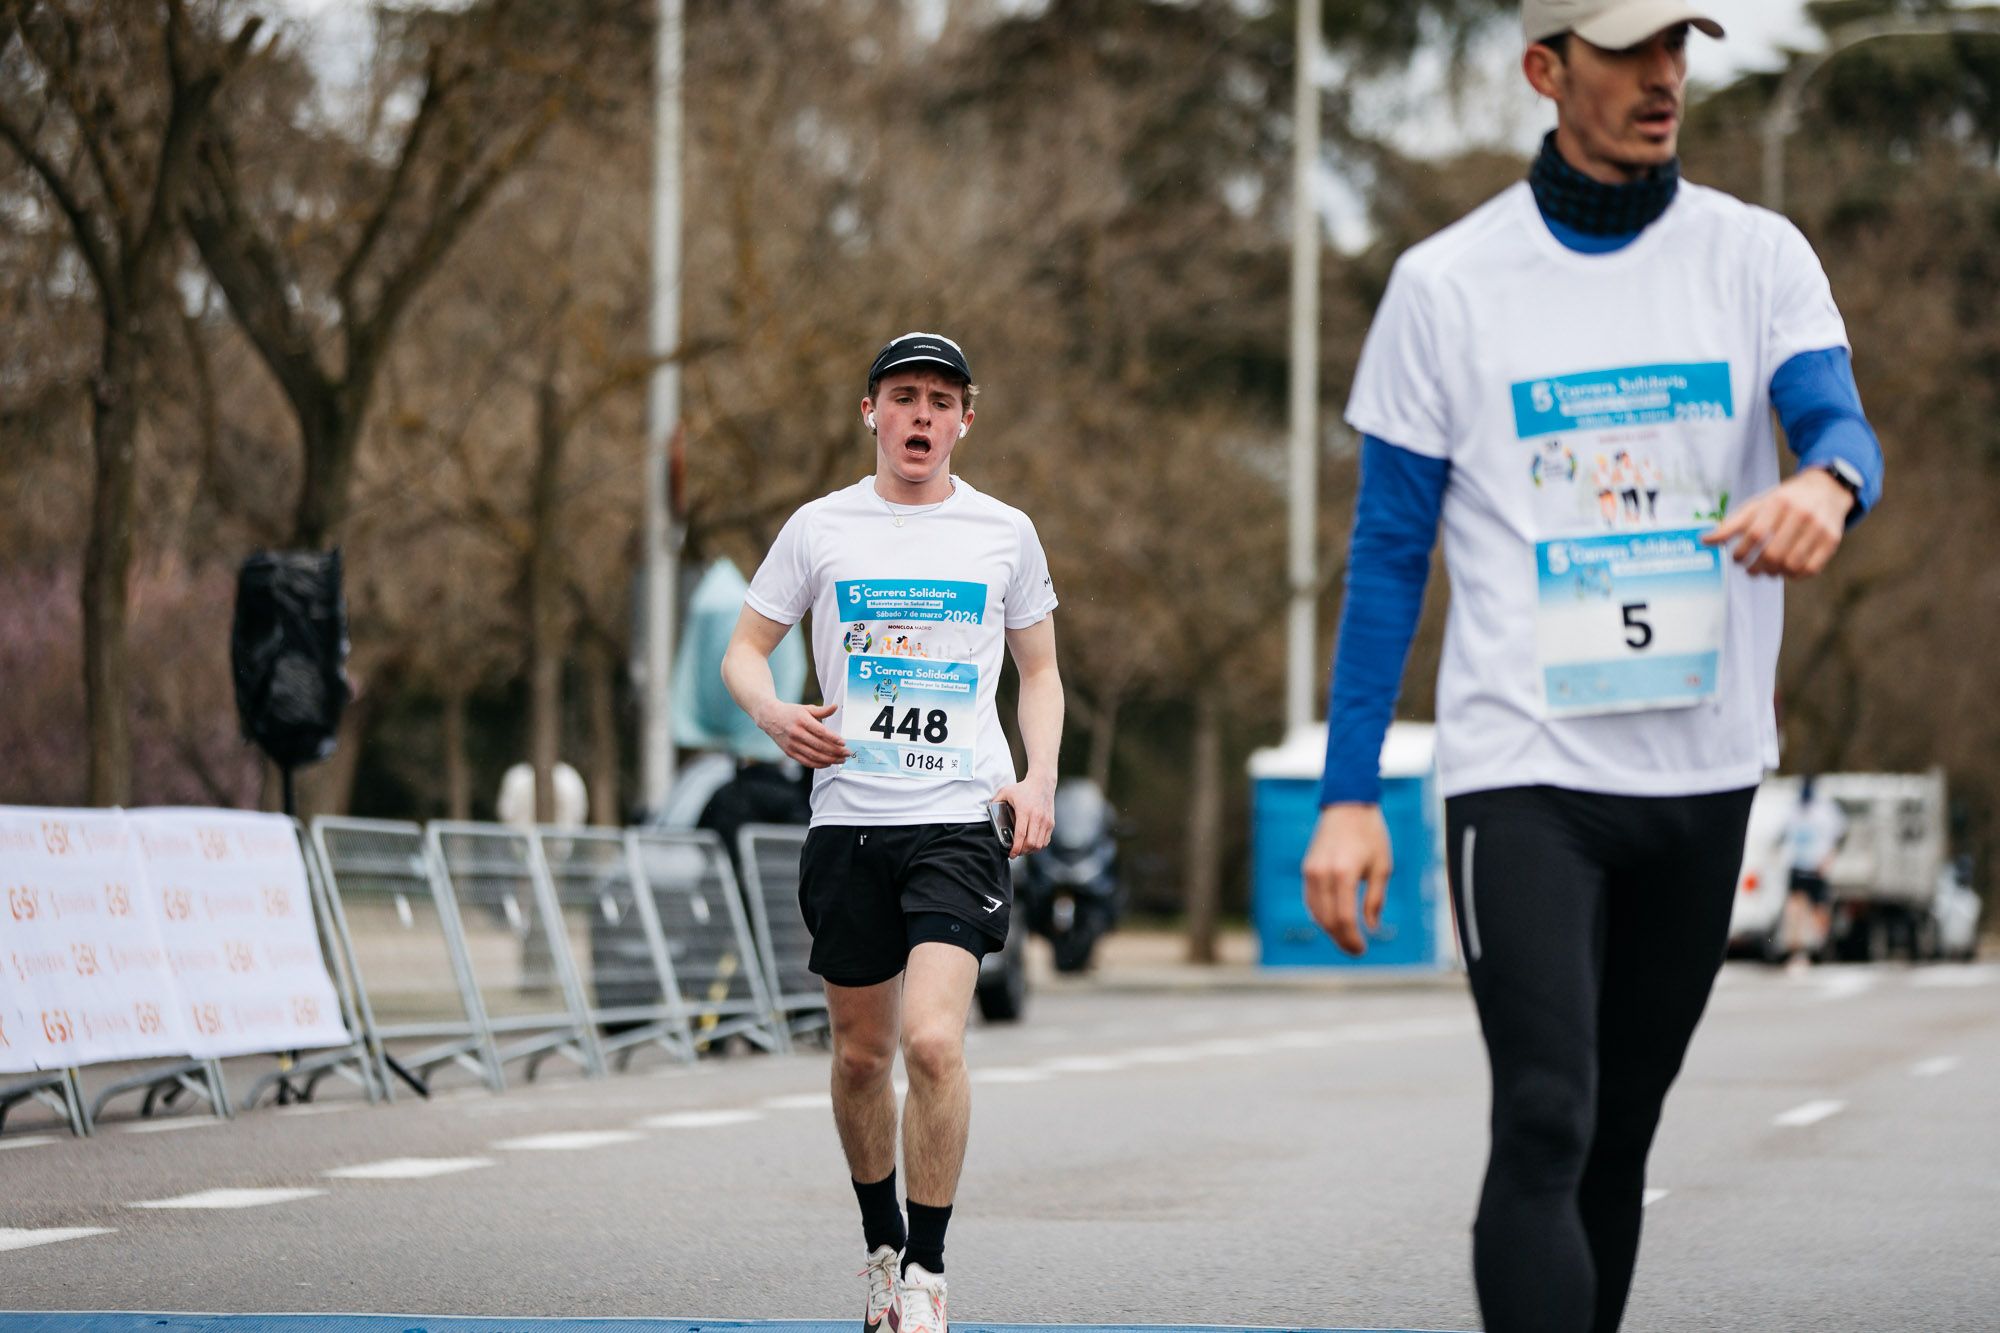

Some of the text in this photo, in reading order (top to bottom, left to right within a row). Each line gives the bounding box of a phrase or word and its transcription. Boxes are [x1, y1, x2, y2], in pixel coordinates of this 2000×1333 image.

[864, 588, 906, 598] Carrera
[909, 588, 957, 599] Solidaria
[876, 610, 901, 618] Sábado
[944, 609, 979, 624] 2026
[853, 623, 865, 631] 20
[1621, 604, 1652, 649] 5
[875, 666, 913, 677] Carrera
[916, 668, 960, 680] Solidaria
[870, 705, 948, 744] 448
[906, 753, 944, 771] 0184
